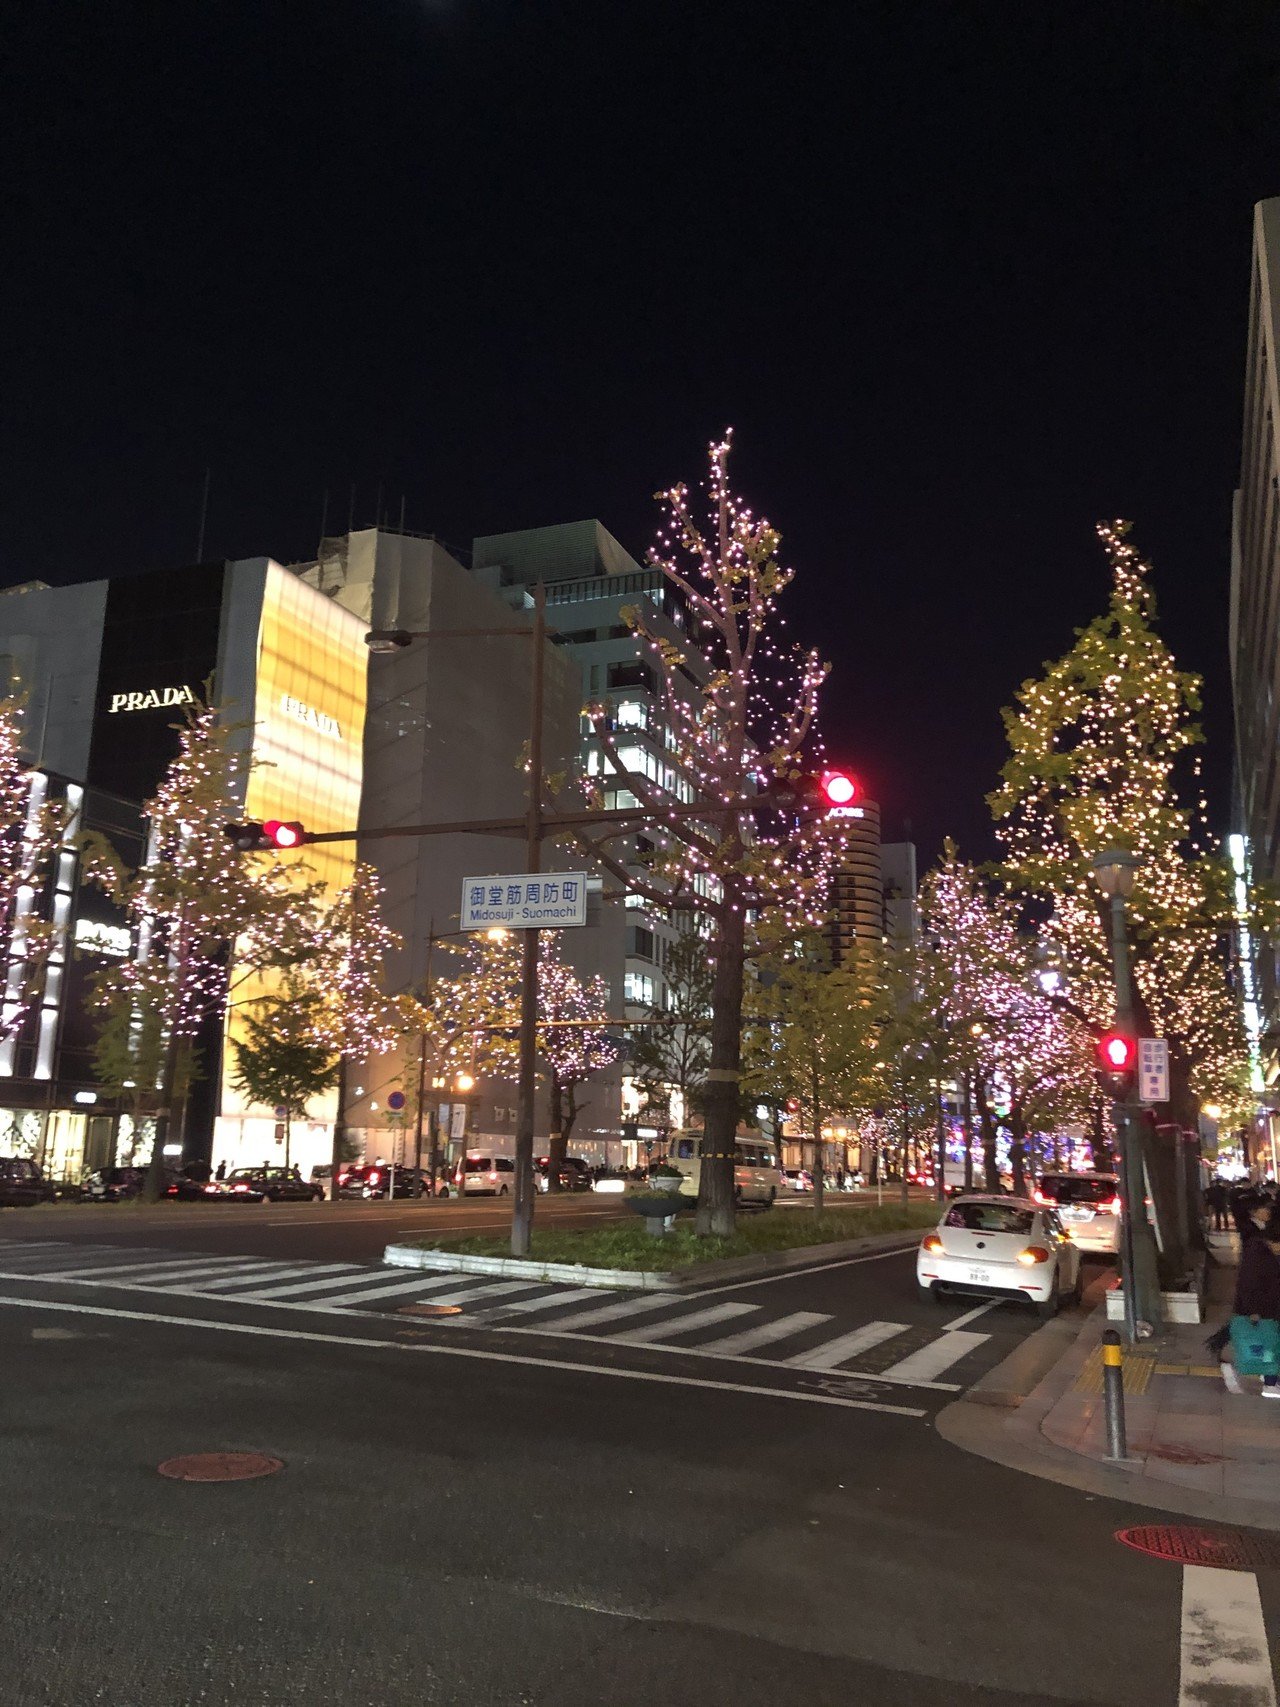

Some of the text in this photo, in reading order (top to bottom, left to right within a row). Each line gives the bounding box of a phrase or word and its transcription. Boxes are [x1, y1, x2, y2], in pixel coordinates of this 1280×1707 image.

[108, 685, 194, 713] PRADA
[280, 694, 342, 740] PRADA
[470, 881, 578, 906] 御堂筋周防町
[470, 908, 514, 921] Midosuji
[522, 905, 576, 919] Suomachi
